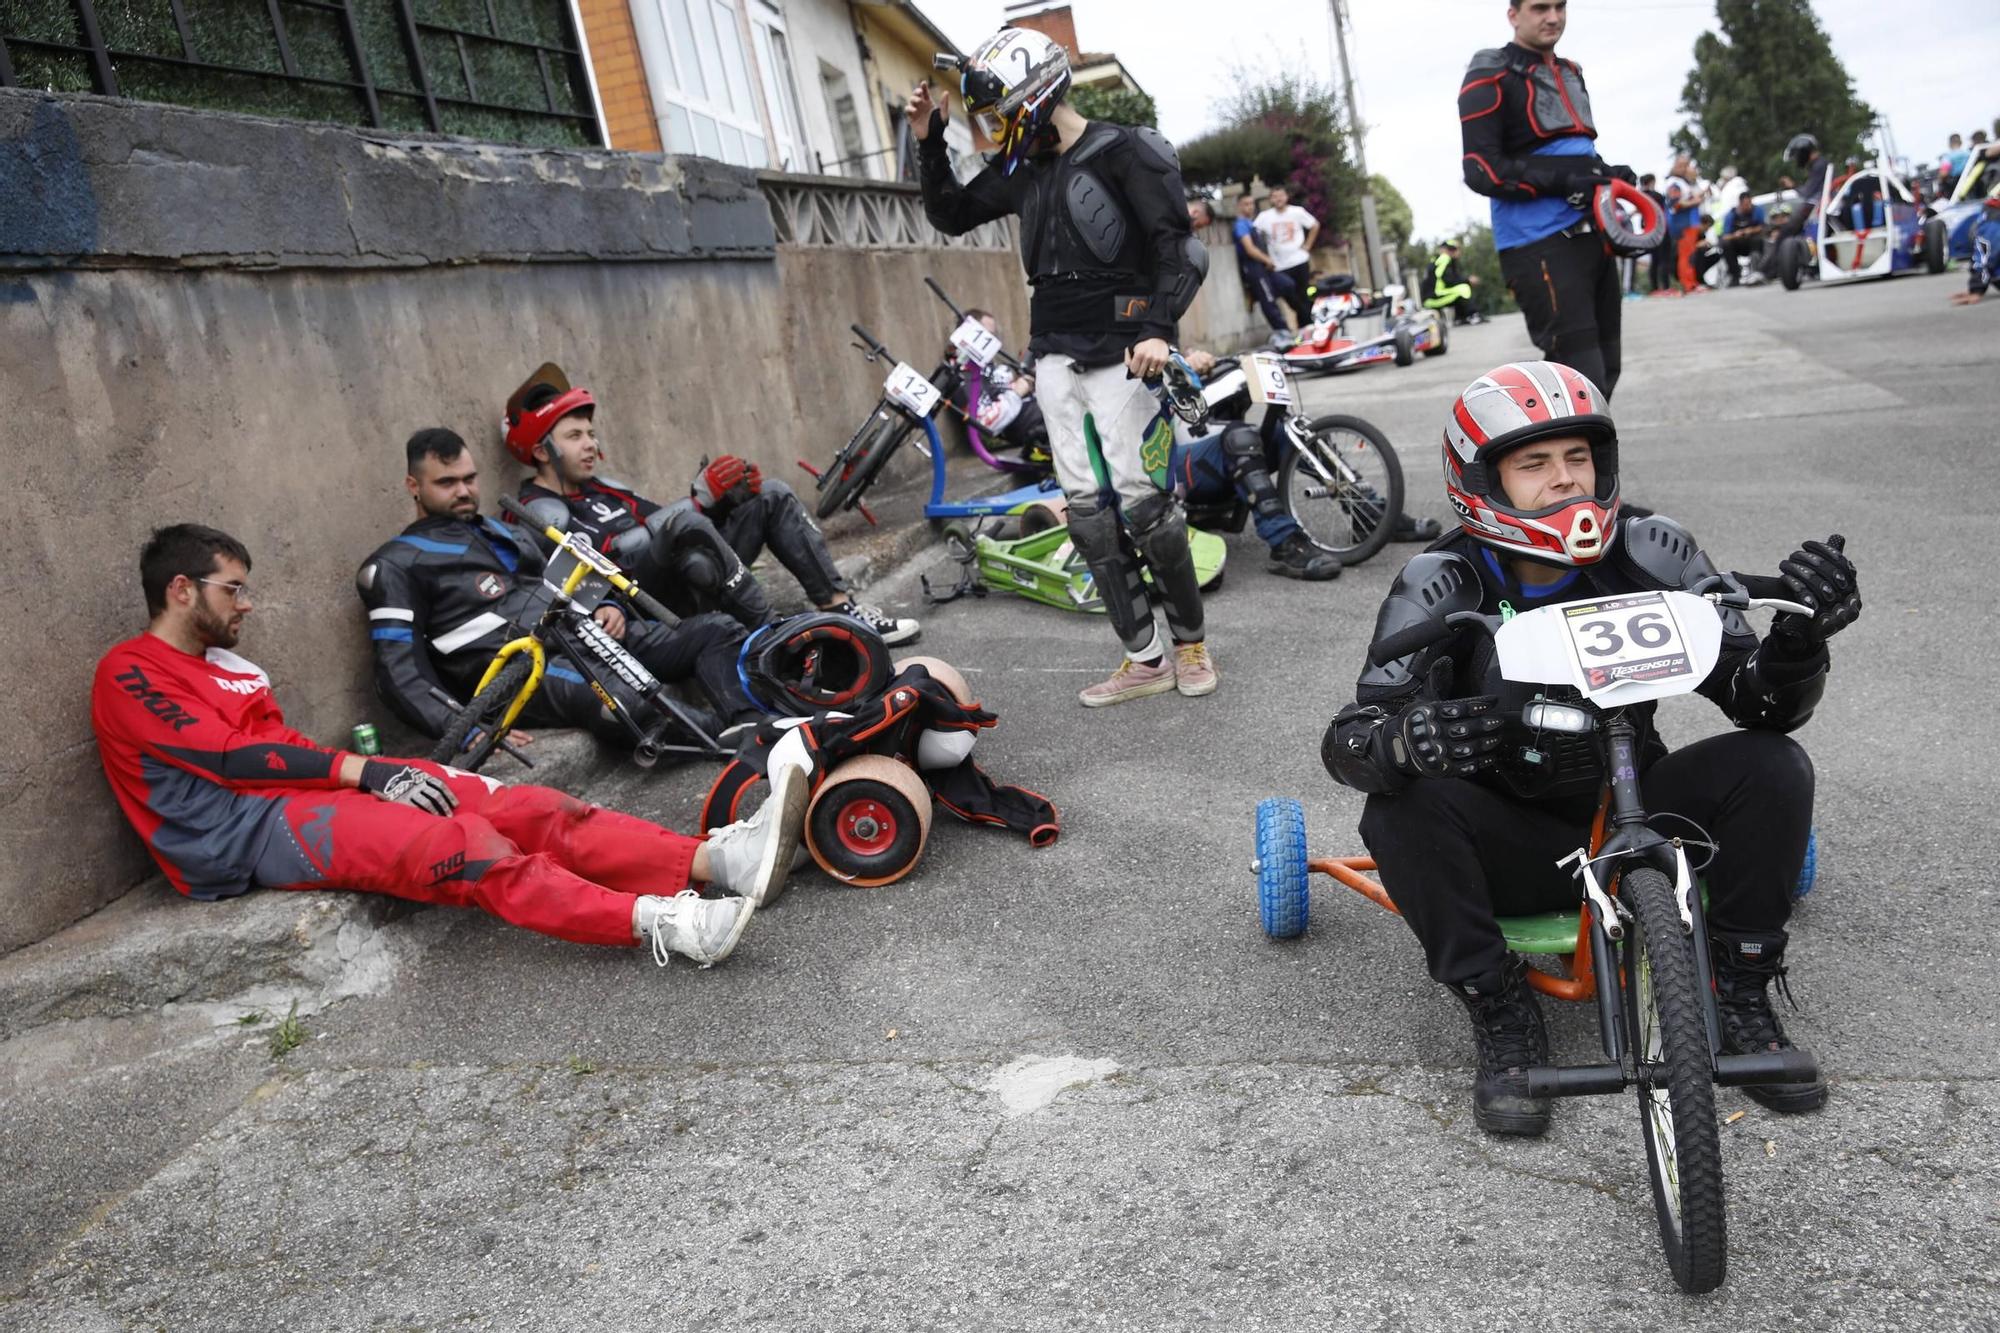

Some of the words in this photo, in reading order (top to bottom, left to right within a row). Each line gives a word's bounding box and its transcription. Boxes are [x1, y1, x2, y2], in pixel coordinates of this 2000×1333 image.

[1010, 46, 1034, 78] 2
[972, 329, 993, 350] 11
[904, 376, 929, 402] 12
[1271, 370, 1285, 389] 9
[1579, 612, 1671, 656] 36
[114, 664, 200, 732] THOR
